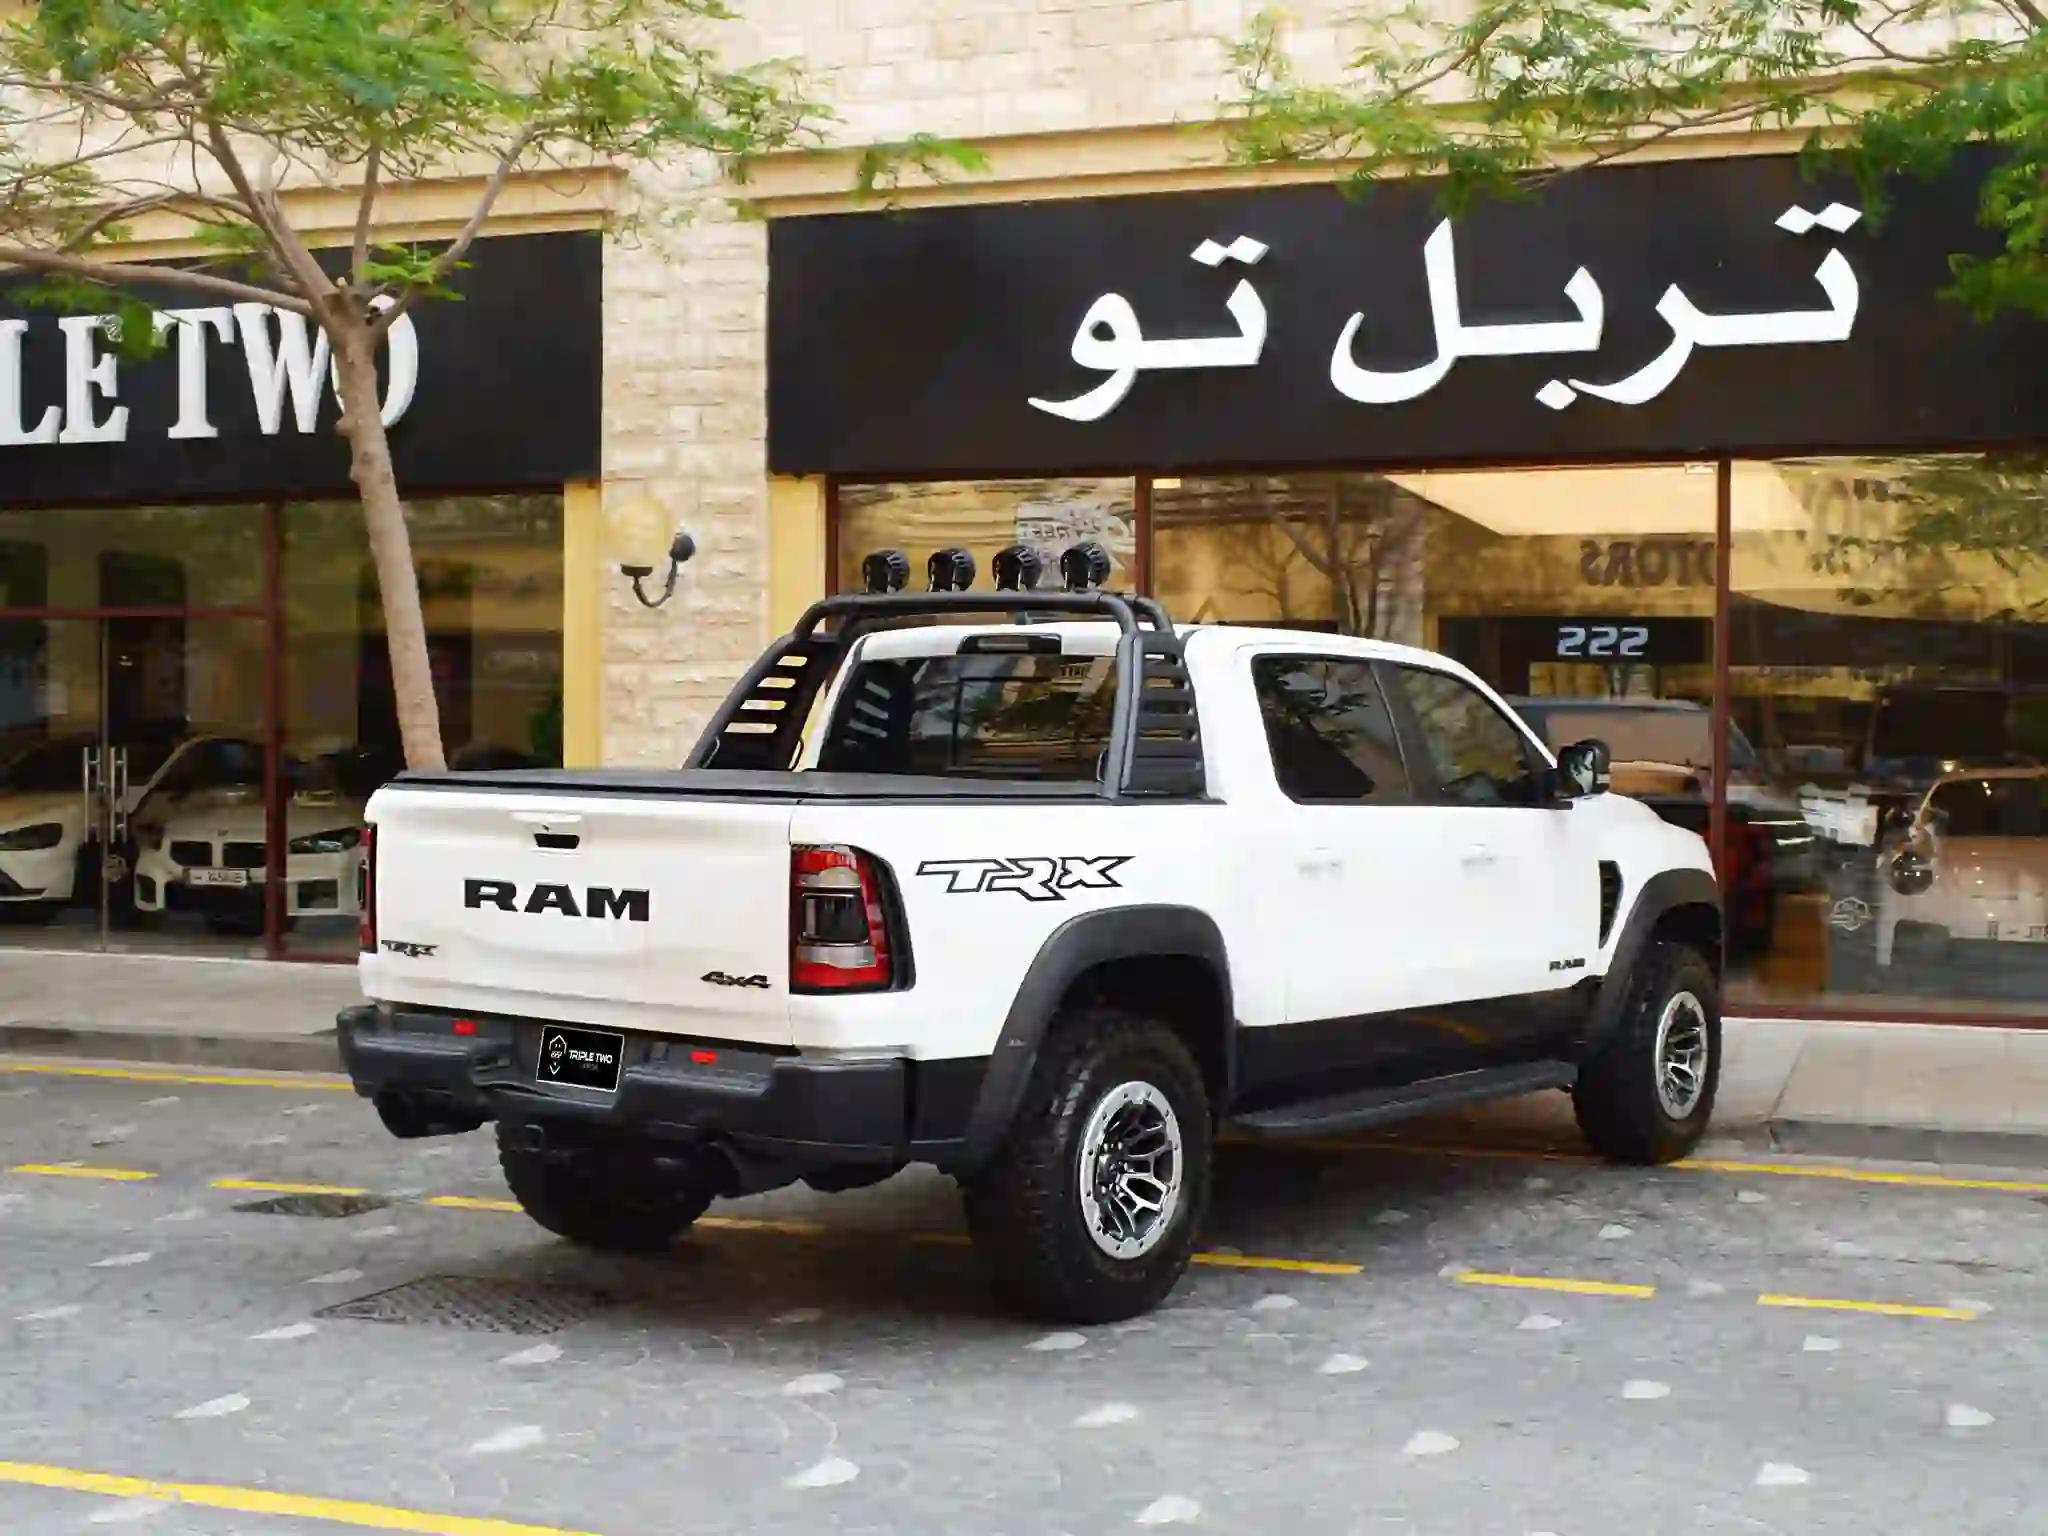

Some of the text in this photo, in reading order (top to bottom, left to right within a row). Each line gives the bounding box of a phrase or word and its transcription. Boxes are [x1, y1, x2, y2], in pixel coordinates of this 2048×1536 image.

[1027, 234, 1269, 422] تو
[1556, 626, 1649, 656] 222
[464, 877, 650, 922] RAM
[915, 855, 1136, 902] TRX
[569, 1049, 613, 1064] TRIPLE TWO
